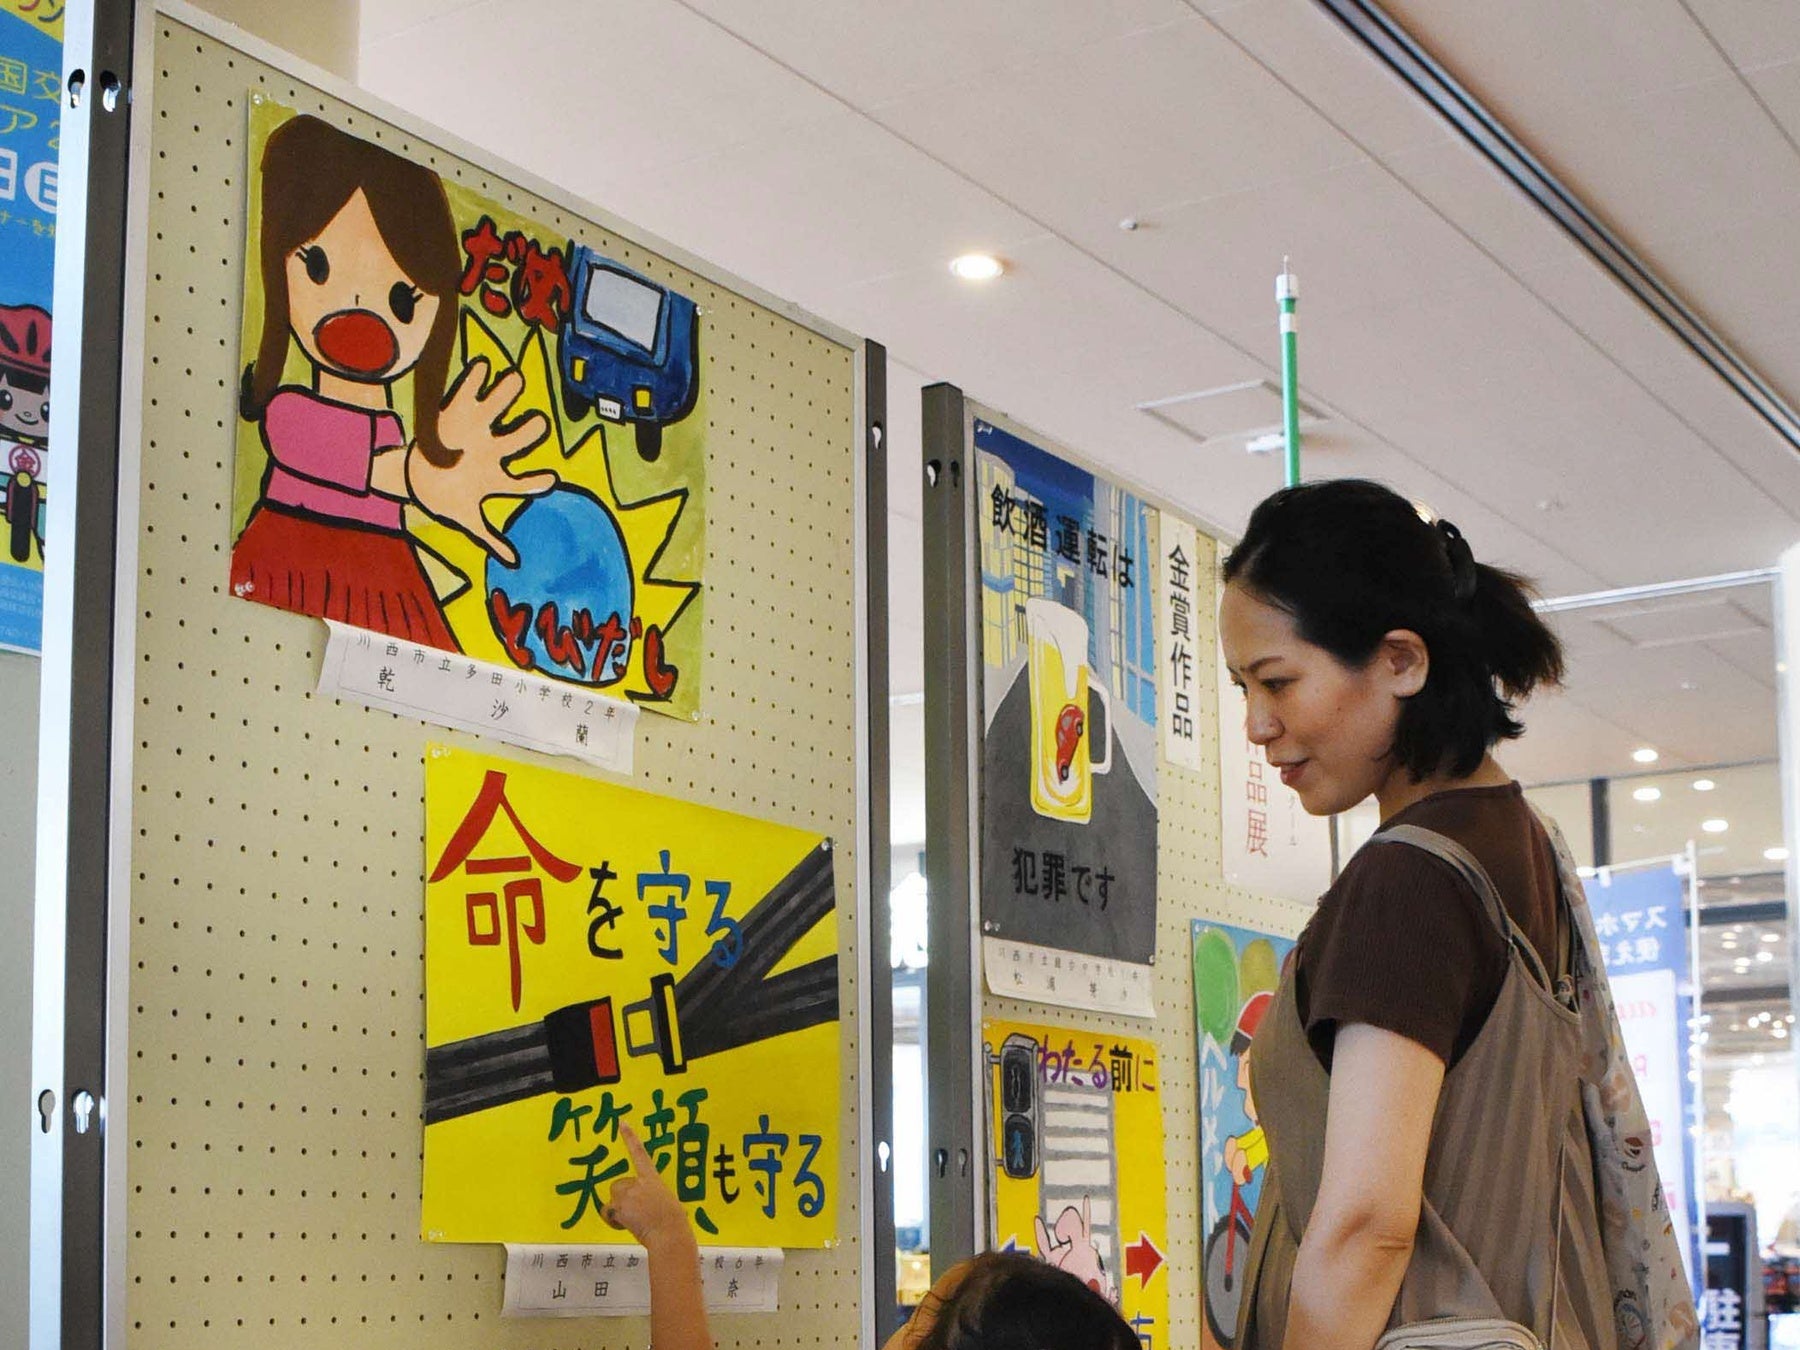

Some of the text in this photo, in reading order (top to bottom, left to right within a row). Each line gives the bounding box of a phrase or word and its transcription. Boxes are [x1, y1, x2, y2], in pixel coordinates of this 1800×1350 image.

[460, 214, 572, 334] だめ
[991, 483, 1134, 589] 飲酒運転は
[357, 632, 617, 721] 川西市立多田小学校2年
[488, 588, 679, 698] とびだし
[1168, 545, 1193, 741] 金賞作品
[428, 770, 744, 1013] 命を守る
[1012, 845, 1115, 912] 犯罪です
[1037, 1034, 1155, 1093] わたる前に
[548, 1088, 826, 1235] 笑顔も守る
